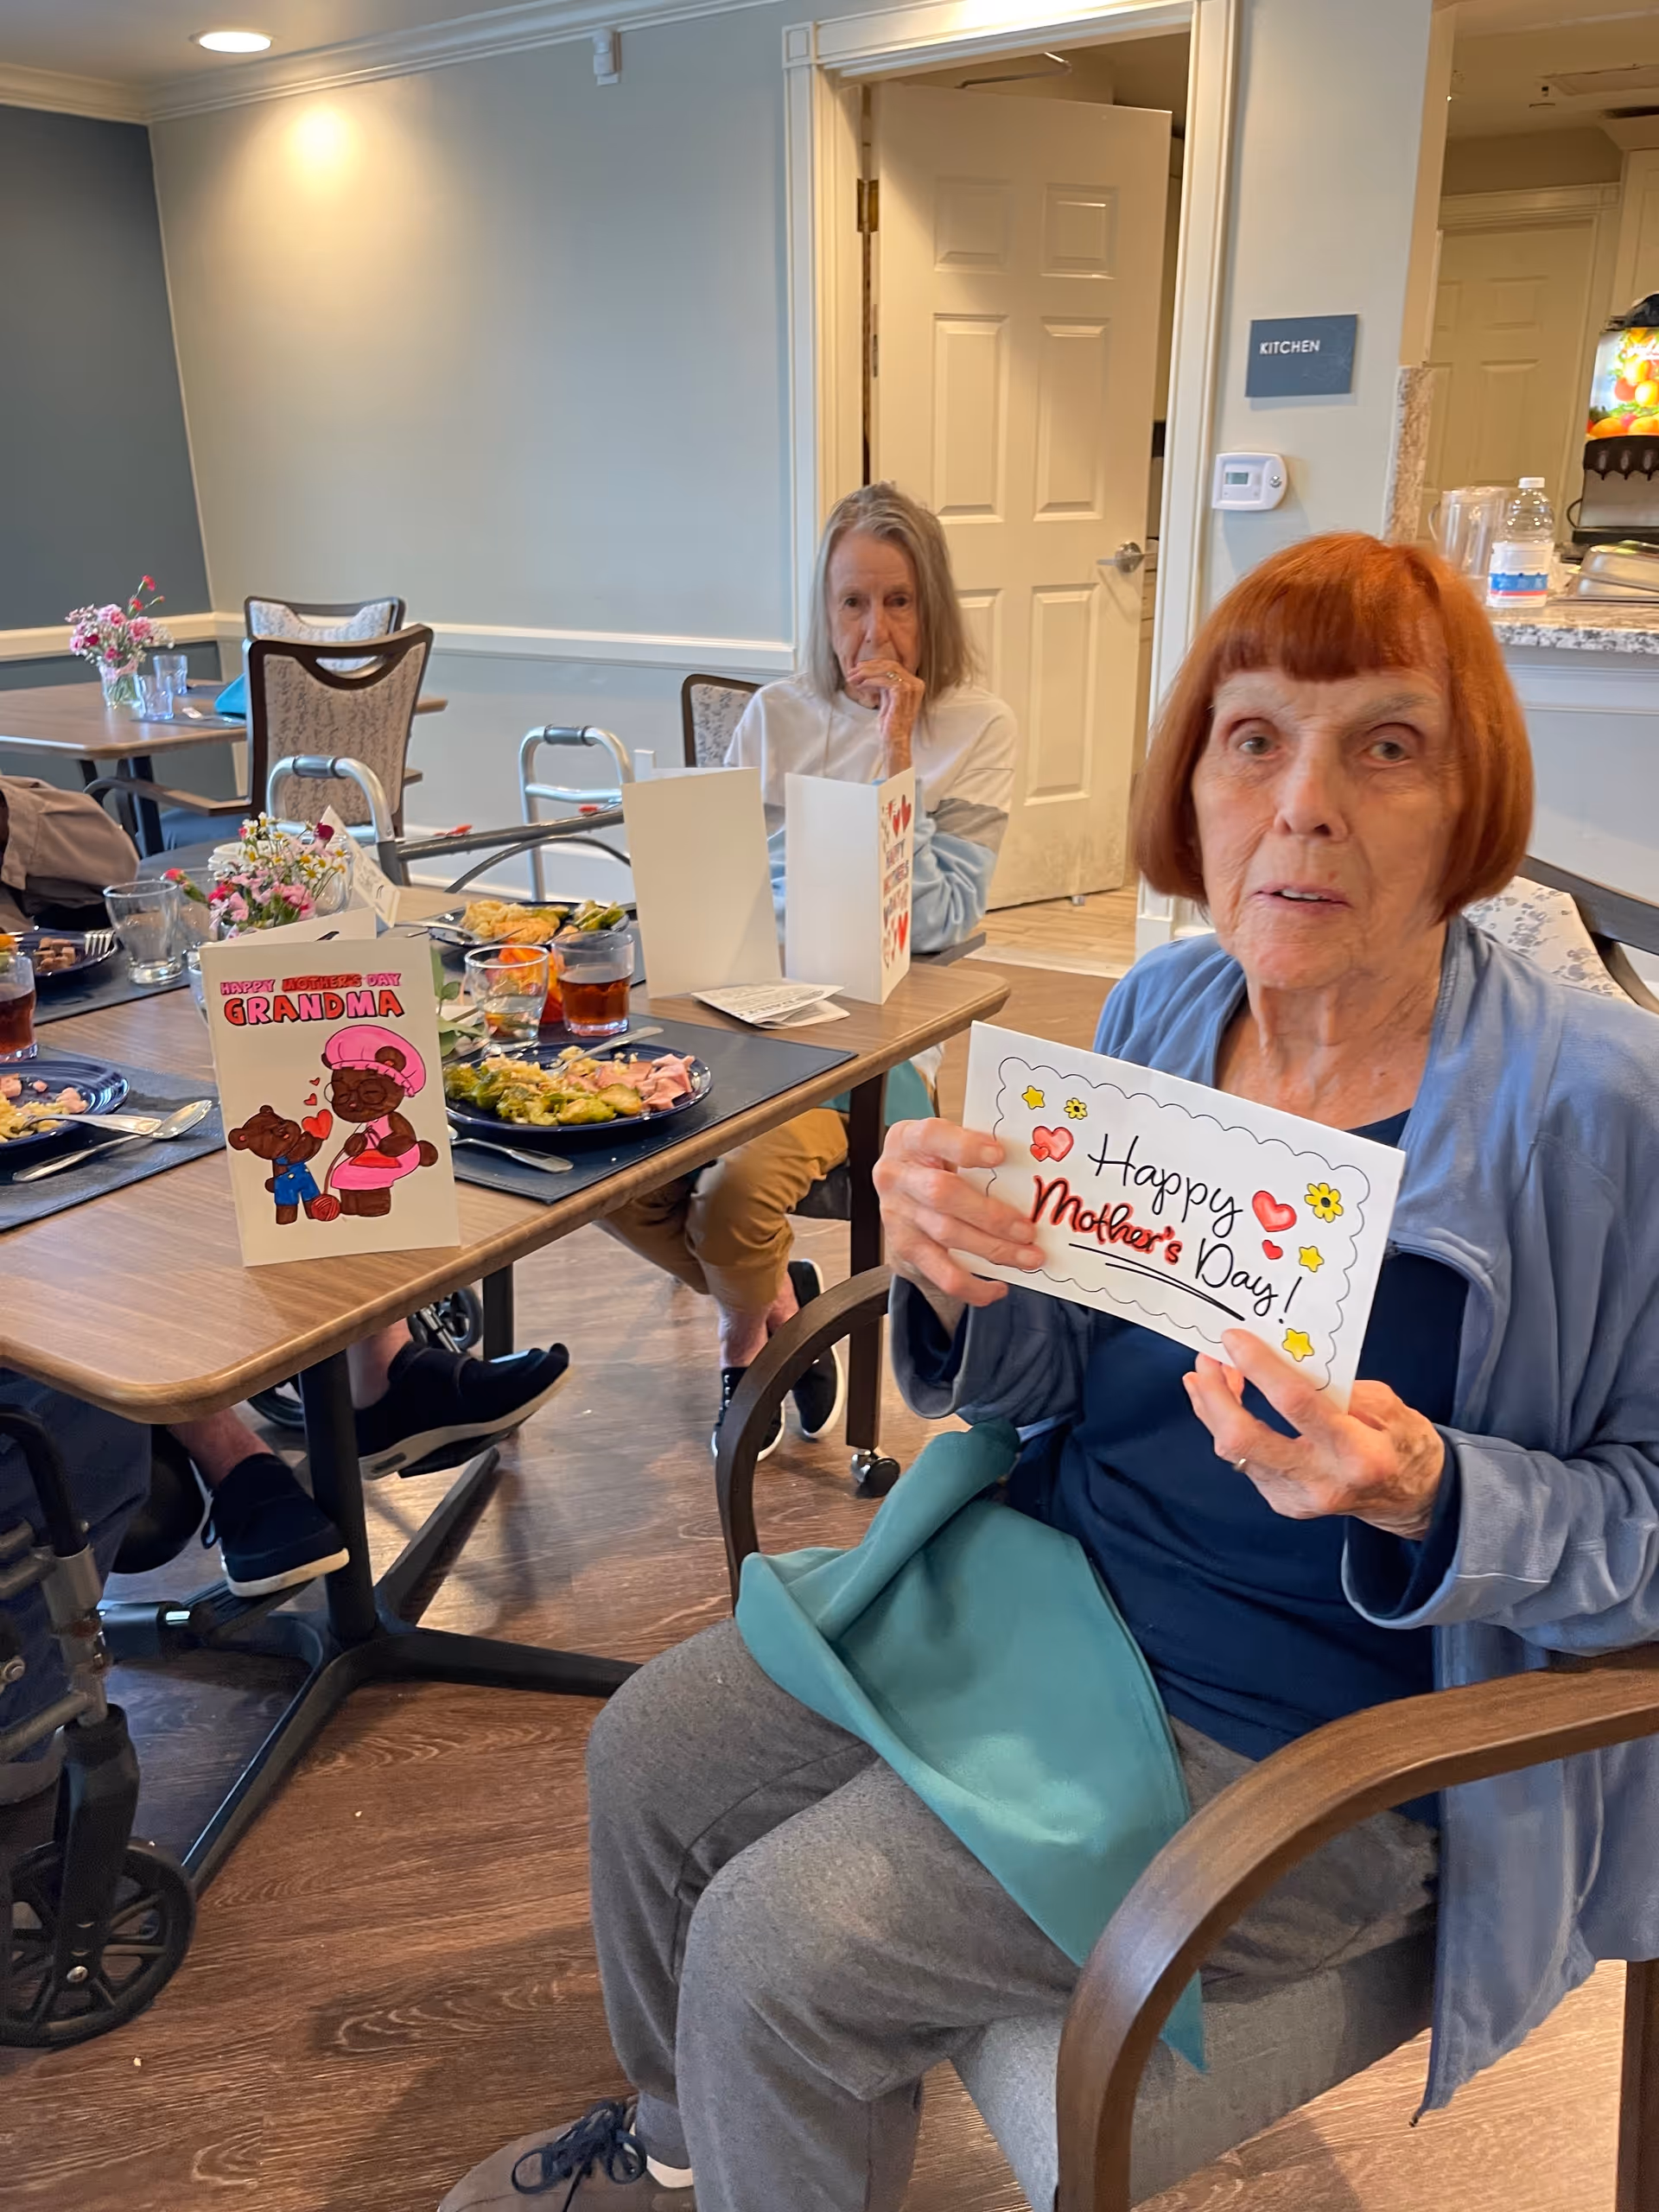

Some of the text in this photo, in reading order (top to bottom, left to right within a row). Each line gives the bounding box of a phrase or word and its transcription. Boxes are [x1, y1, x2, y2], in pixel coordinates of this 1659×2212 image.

[1259, 340, 1321, 355] KITCHEN
[220, 979, 276, 995] HAPPY
[365, 973, 402, 987] DAY
[224, 989, 405, 1027] GRANDMA
[1087, 1133, 1243, 1238] Happy
[1032, 1175, 1303, 1324] Mother's Day!
